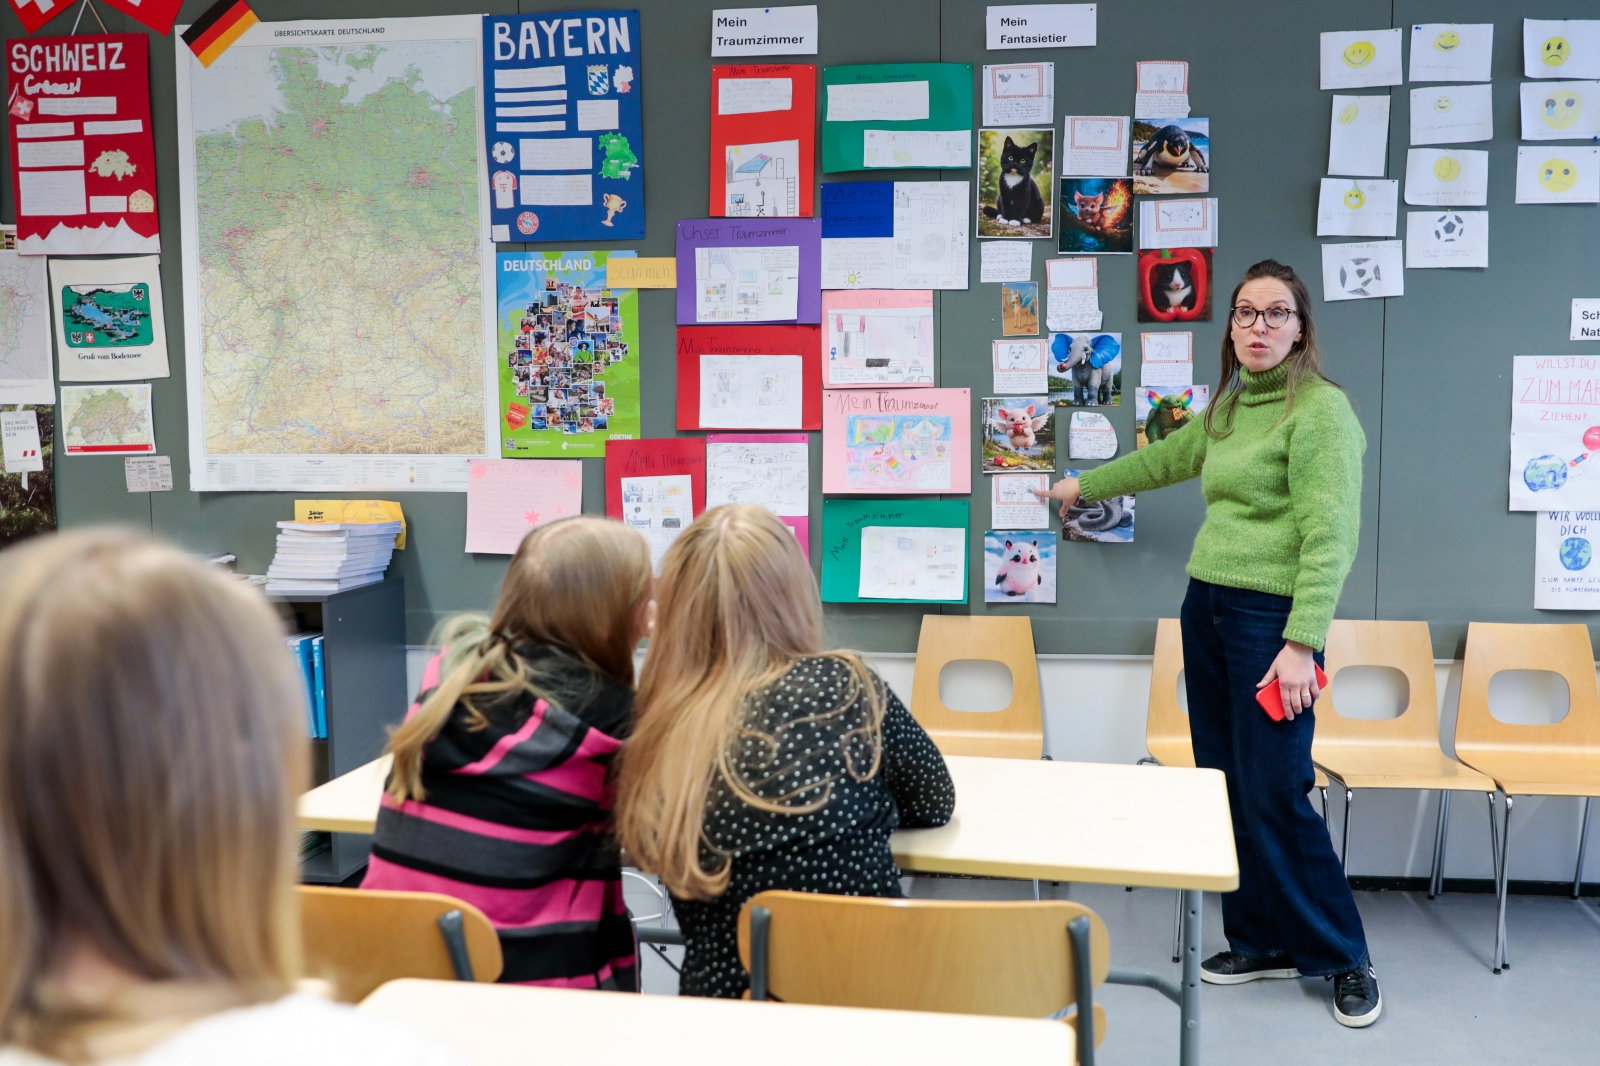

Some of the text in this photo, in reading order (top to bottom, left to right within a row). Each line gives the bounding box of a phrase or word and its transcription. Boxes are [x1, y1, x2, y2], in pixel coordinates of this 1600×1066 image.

[717, 17, 747, 28] Mein
[1000, 17, 1027, 27] Mein
[274, 27, 386, 37] ÜBERSICHTSKARTE DEUTSCHLAND
[494, 17, 631, 61] BAYERN
[717, 35, 804, 47] Traumzimmer
[1000, 34, 1067, 44] Fantasietier
[12, 42, 126, 73] SCHWEIZ
[824, 186, 882, 201] Mein
[822, 205, 885, 223] Traumzimmer
[682, 226, 722, 240] Unser
[503, 259, 592, 272] DEUTSCHLAND
[78, 352, 95, 360] Gruß
[1535, 357, 1596, 370] WILLST DU
[1520, 378, 1561, 402] ZUM
[834, 393, 872, 415] Mein
[1540, 410, 1587, 421] ZIEHEN?
[489, 461, 559, 477] THÜRINGEN
[1548, 511, 1570, 522] WIR
[830, 511, 904, 562] Mein Traumzimmer
[1560, 524, 1587, 537] DICH
